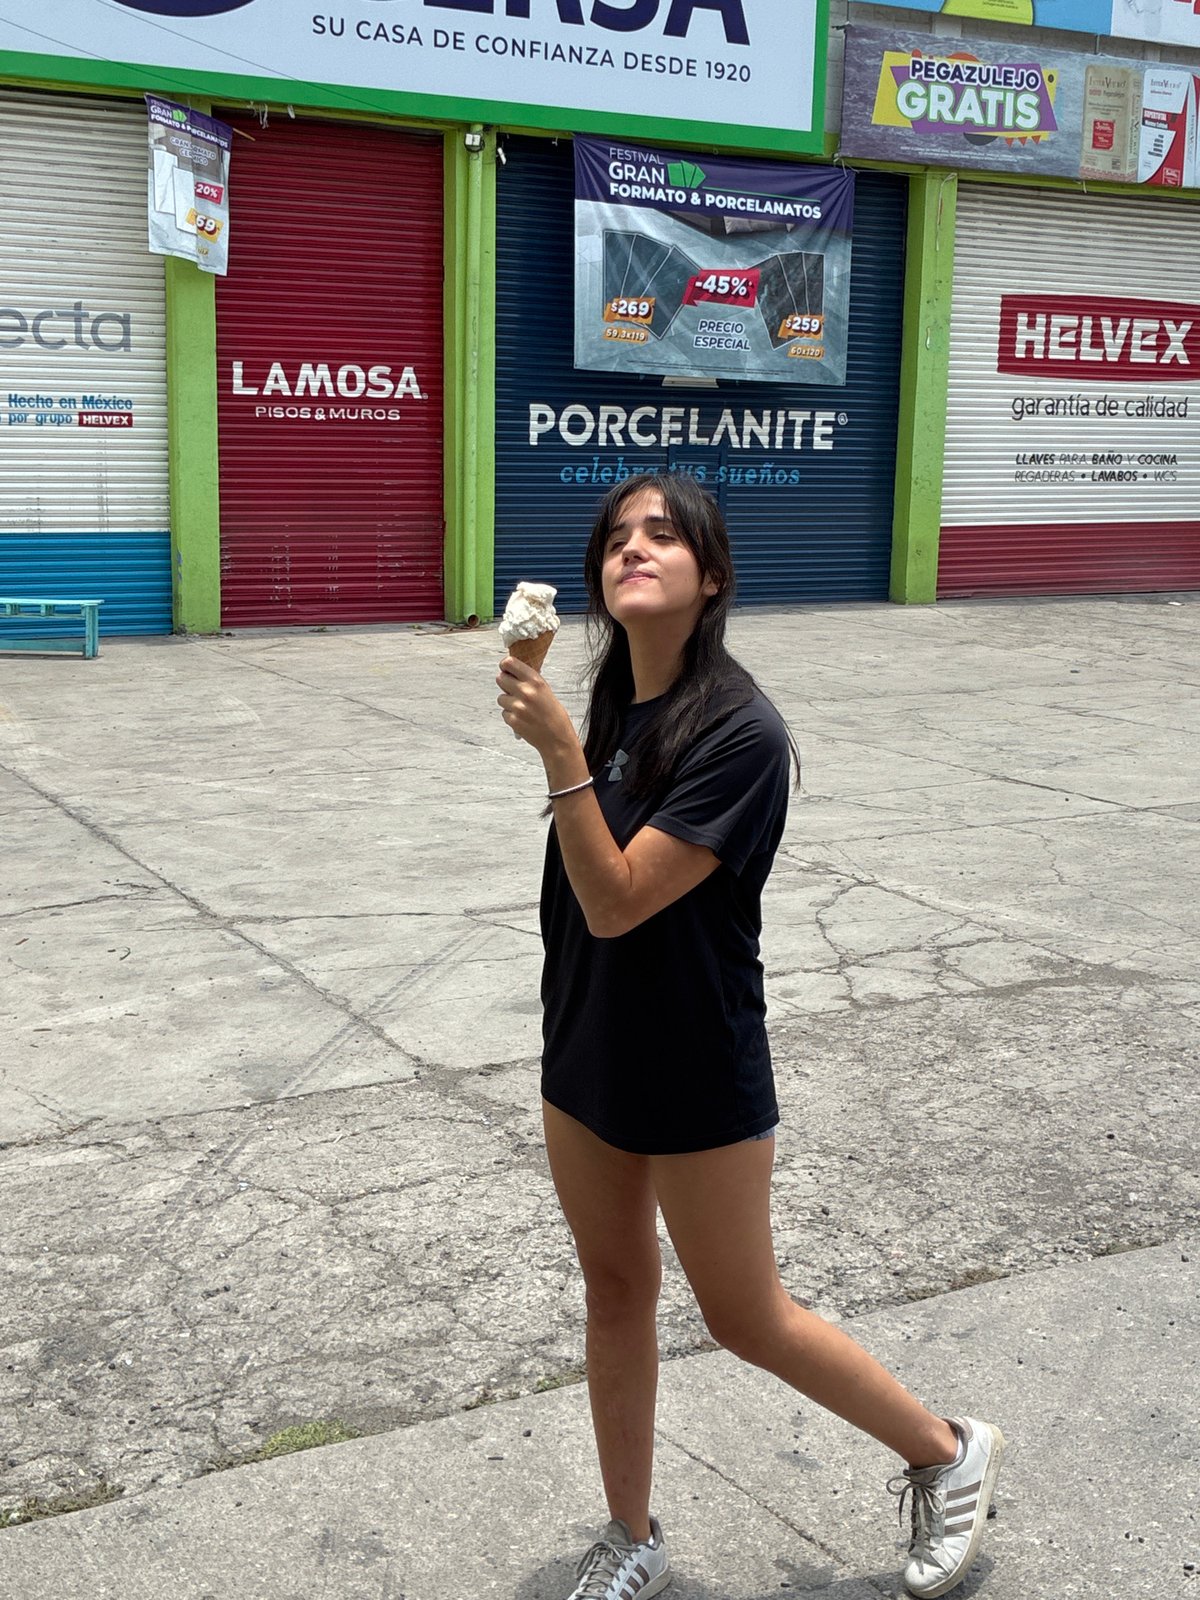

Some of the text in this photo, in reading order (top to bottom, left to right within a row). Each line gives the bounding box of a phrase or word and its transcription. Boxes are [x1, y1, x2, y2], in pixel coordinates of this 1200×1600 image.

[312, 15, 346, 37] SU
[355, 20, 424, 47] CASA
[432, 29, 466, 51] DE
[474, 34, 616, 69] CONFIANZA
[623, 51, 698, 77] DESDE
[705, 60, 752, 83] 1920
[910, 58, 1040, 90] PEGAZULEJO
[150, 105, 173, 119] GRAN
[895, 79, 1042, 131] GRATIS
[609, 147, 665, 166] FESTIVAL
[608, 161, 665, 186] GRAN
[609, 183, 822, 220] FORMATO & PORCELANATOS
[610, 299, 650, 317] $269
[699, 320, 744, 334] PRECIO
[785, 316, 820, 333] $259
[694, 336, 751, 351] ESPECIAL
[1014, 312, 1194, 365] HELVEX
[8, 393, 133, 410] Hecho en México
[1011, 394, 1188, 421] garantía de calidad
[8, 412, 129, 426] por grupo HELVEX
[1015, 450, 1178, 465] LLAVES PARA BAÑO Y COCINA
[715, 462, 800, 485] sueños
[1014, 470, 1075, 483] REGADERAS
[1091, 471, 1138, 482] LAVABOS
